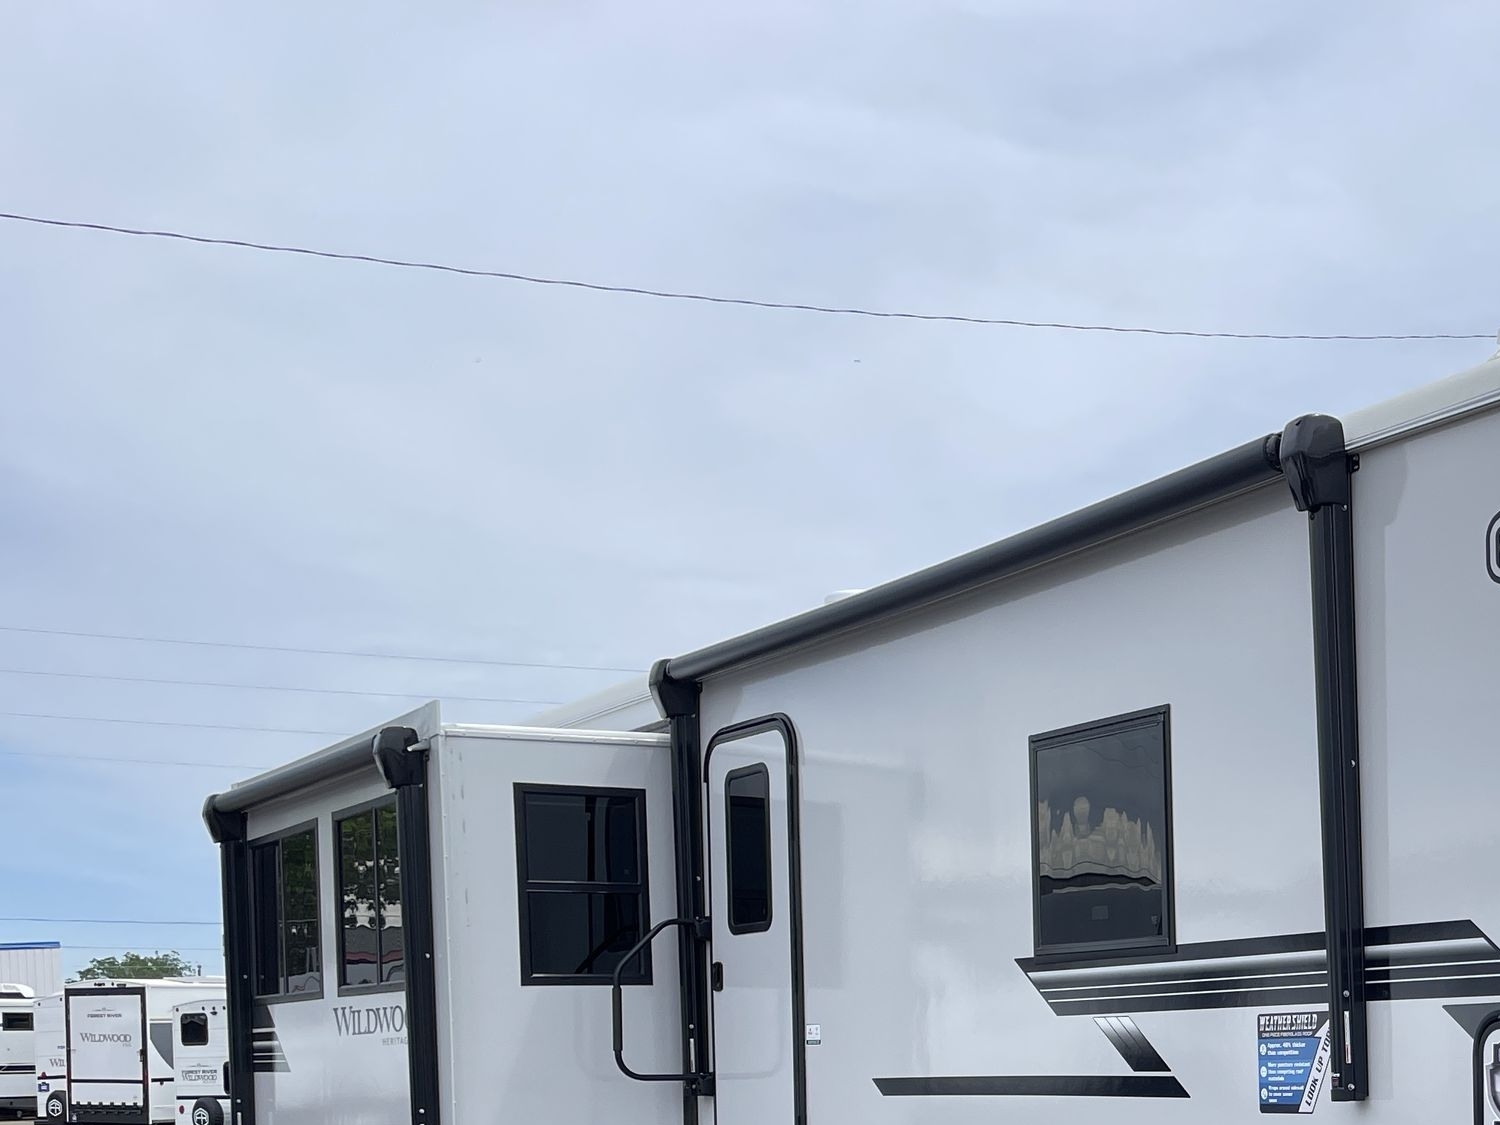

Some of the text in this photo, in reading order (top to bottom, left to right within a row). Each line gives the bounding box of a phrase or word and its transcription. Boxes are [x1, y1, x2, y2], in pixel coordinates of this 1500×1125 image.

[333, 1005, 408, 1036] WILDWO
[80, 1032, 132, 1043] WILDWOOD
[1305, 1077, 1319, 1107] LOOK
[1315, 1055, 1324, 1074] UP
